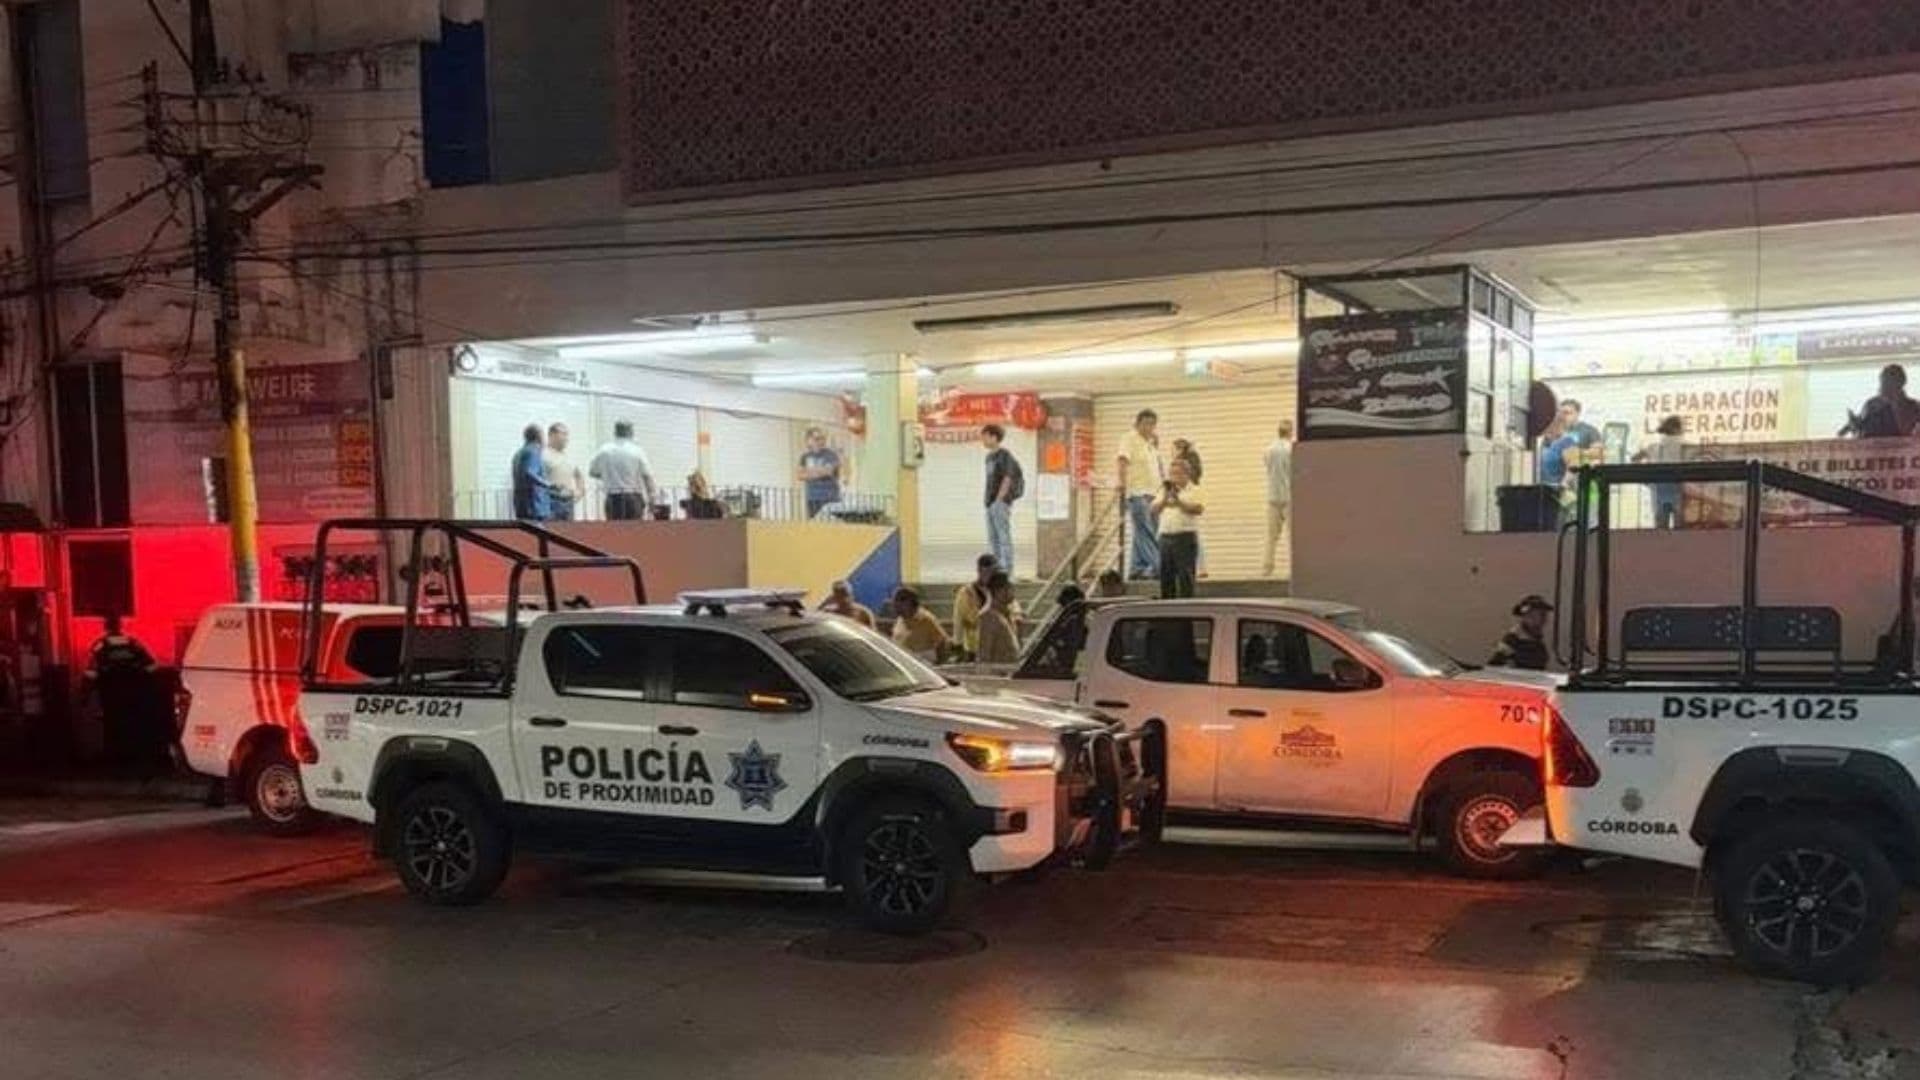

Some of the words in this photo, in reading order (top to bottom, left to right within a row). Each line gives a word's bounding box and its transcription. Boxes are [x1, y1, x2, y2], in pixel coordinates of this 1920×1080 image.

[1645, 389, 1779, 412] REPARACION
[1645, 413, 1778, 434] LERACION
[355, 697, 463, 718] DSPC-1021
[1662, 696, 1859, 720] DSPC-1025
[541, 741, 714, 784] POLICÍA
[545, 781, 572, 799] DE
[578, 783, 715, 806] PROXIMIDAD
